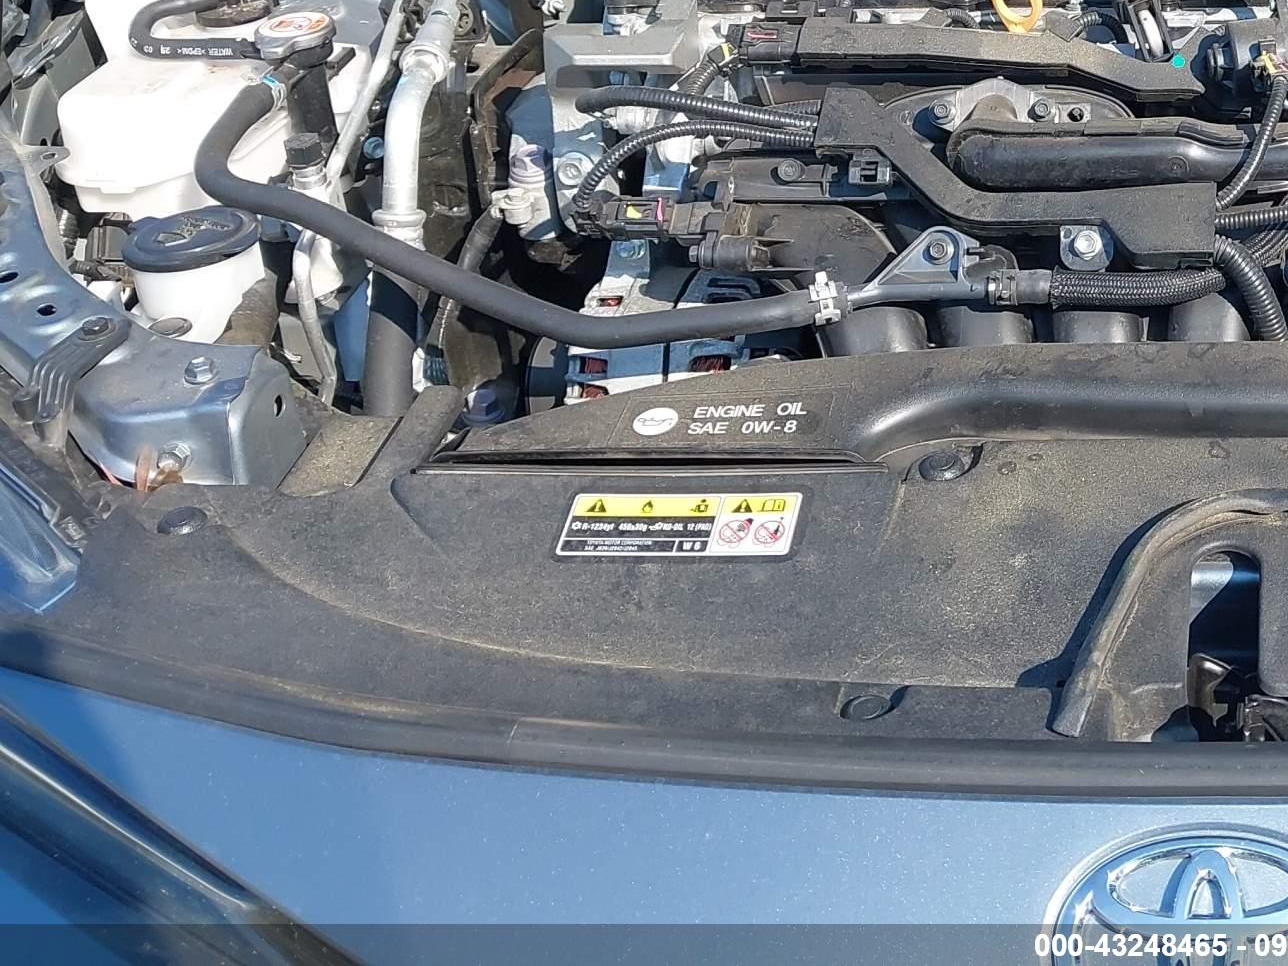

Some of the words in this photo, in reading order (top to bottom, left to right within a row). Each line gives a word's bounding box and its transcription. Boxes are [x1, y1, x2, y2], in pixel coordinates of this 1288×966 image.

[207, 47, 234, 56] WATER
[693, 404, 766, 418] ENGINE
[776, 402, 808, 415] OIL
[687, 421, 729, 434] SAE
[741, 420, 798, 434] 0W-8
